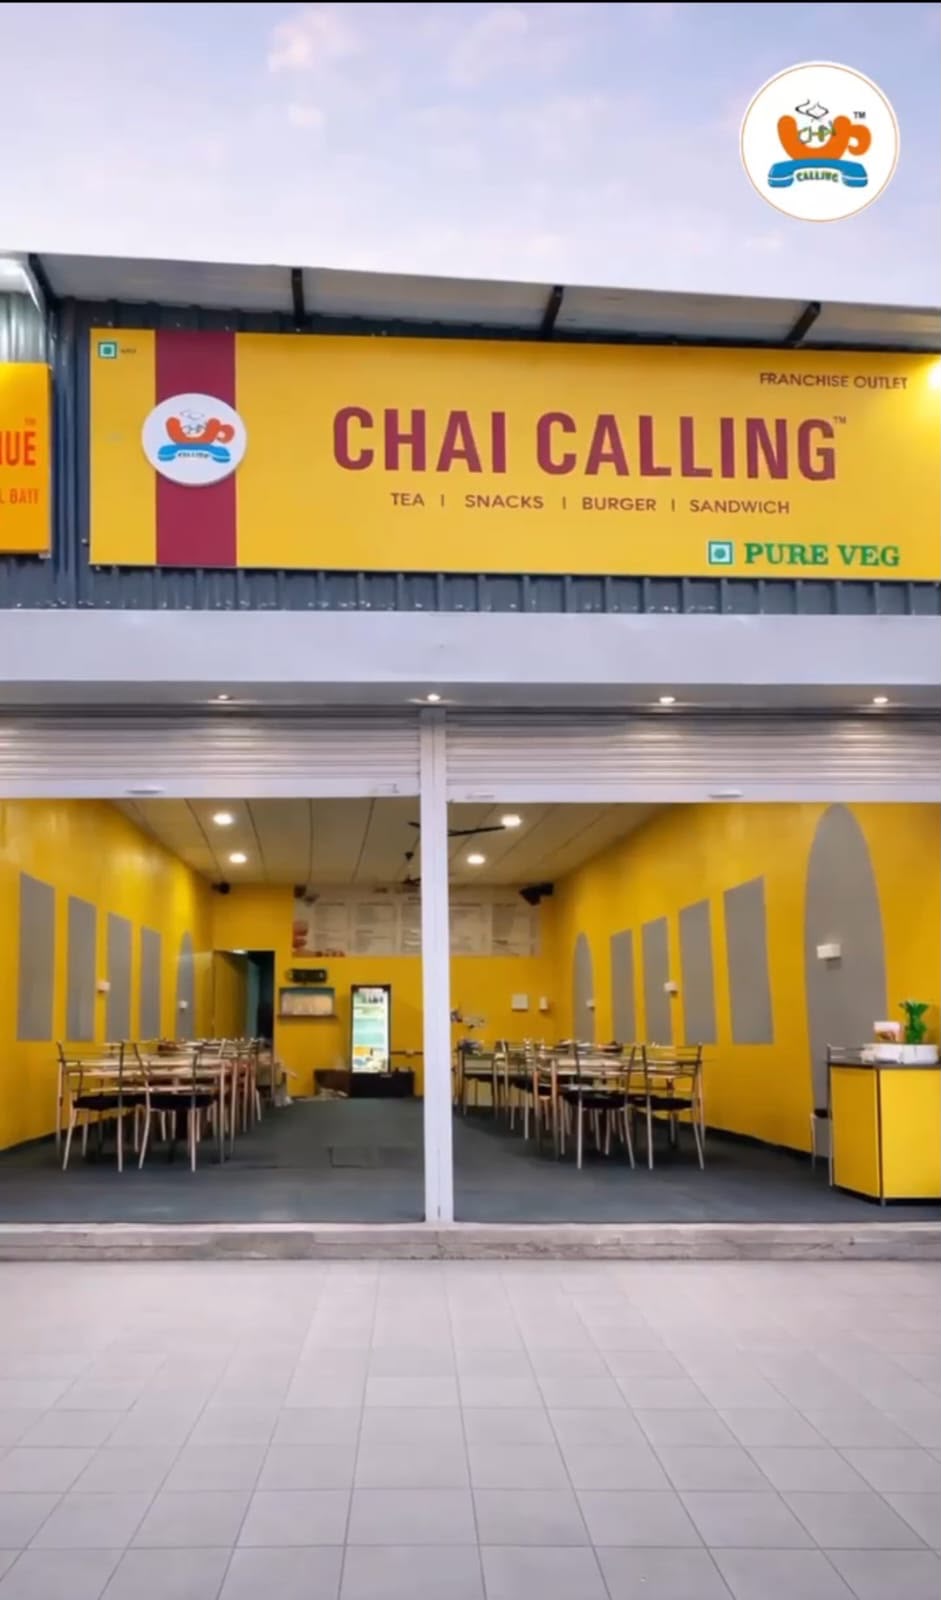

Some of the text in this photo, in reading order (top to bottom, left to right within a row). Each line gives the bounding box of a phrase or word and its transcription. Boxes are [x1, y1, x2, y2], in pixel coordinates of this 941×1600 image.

[759, 371, 908, 390] FRANCHISE OUTLET
[333, 406, 507, 473] CHAI
[536, 411, 836, 481] CALLING
[391, 493, 425, 507] TEA
[465, 494, 544, 510] SNACKS
[582, 496, 657, 512] BURGER
[689, 499, 790, 514] SANDWICH
[744, 543, 900, 567] PURE VEG
